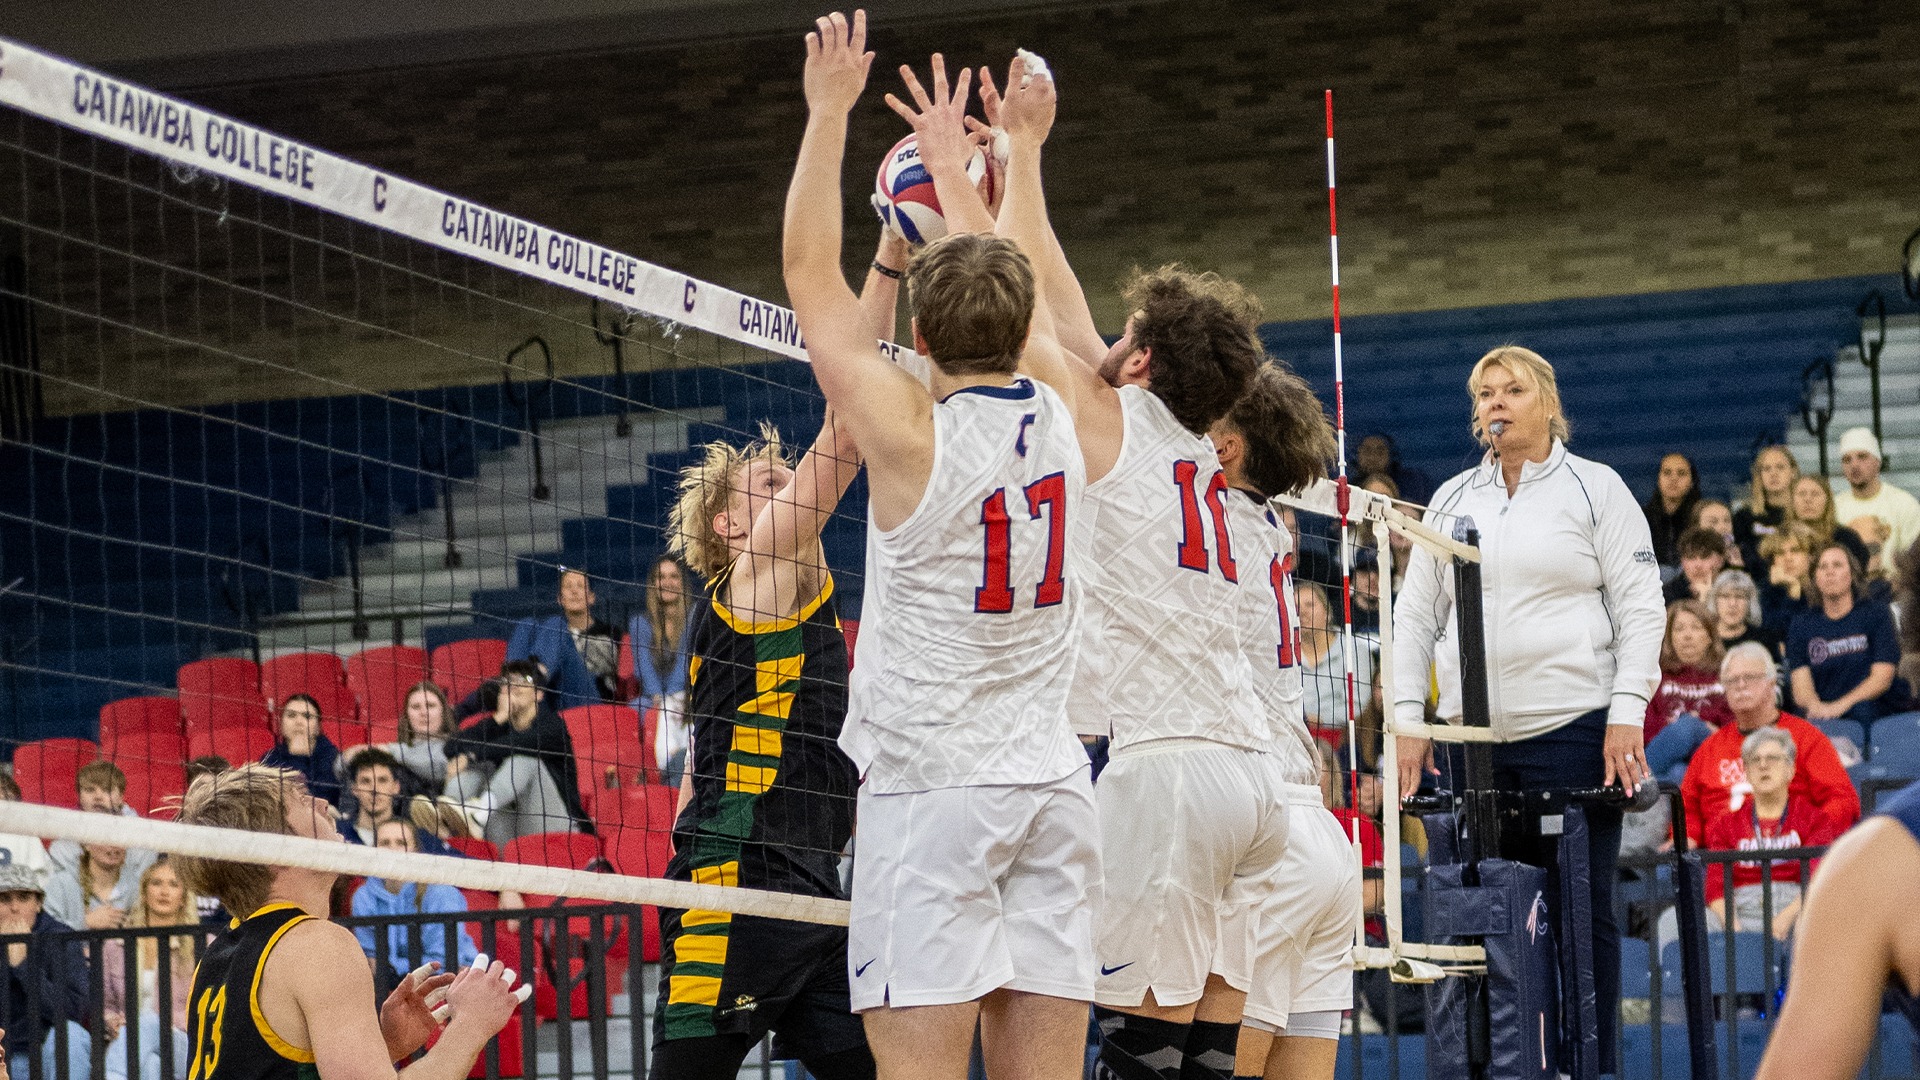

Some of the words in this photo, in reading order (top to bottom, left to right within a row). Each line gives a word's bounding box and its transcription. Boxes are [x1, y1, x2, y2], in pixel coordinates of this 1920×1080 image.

[73, 73, 195, 152] CATAWBA
[205, 117, 315, 190] COLLEGE
[373, 176, 387, 212] C
[442, 198, 541, 265] CATAWBA
[547, 234, 637, 295] COLLEGE
[684, 279, 697, 312] C
[739, 298, 806, 349] CATAW
[973, 470, 1066, 614] 17
[188, 983, 226, 1080] 13
